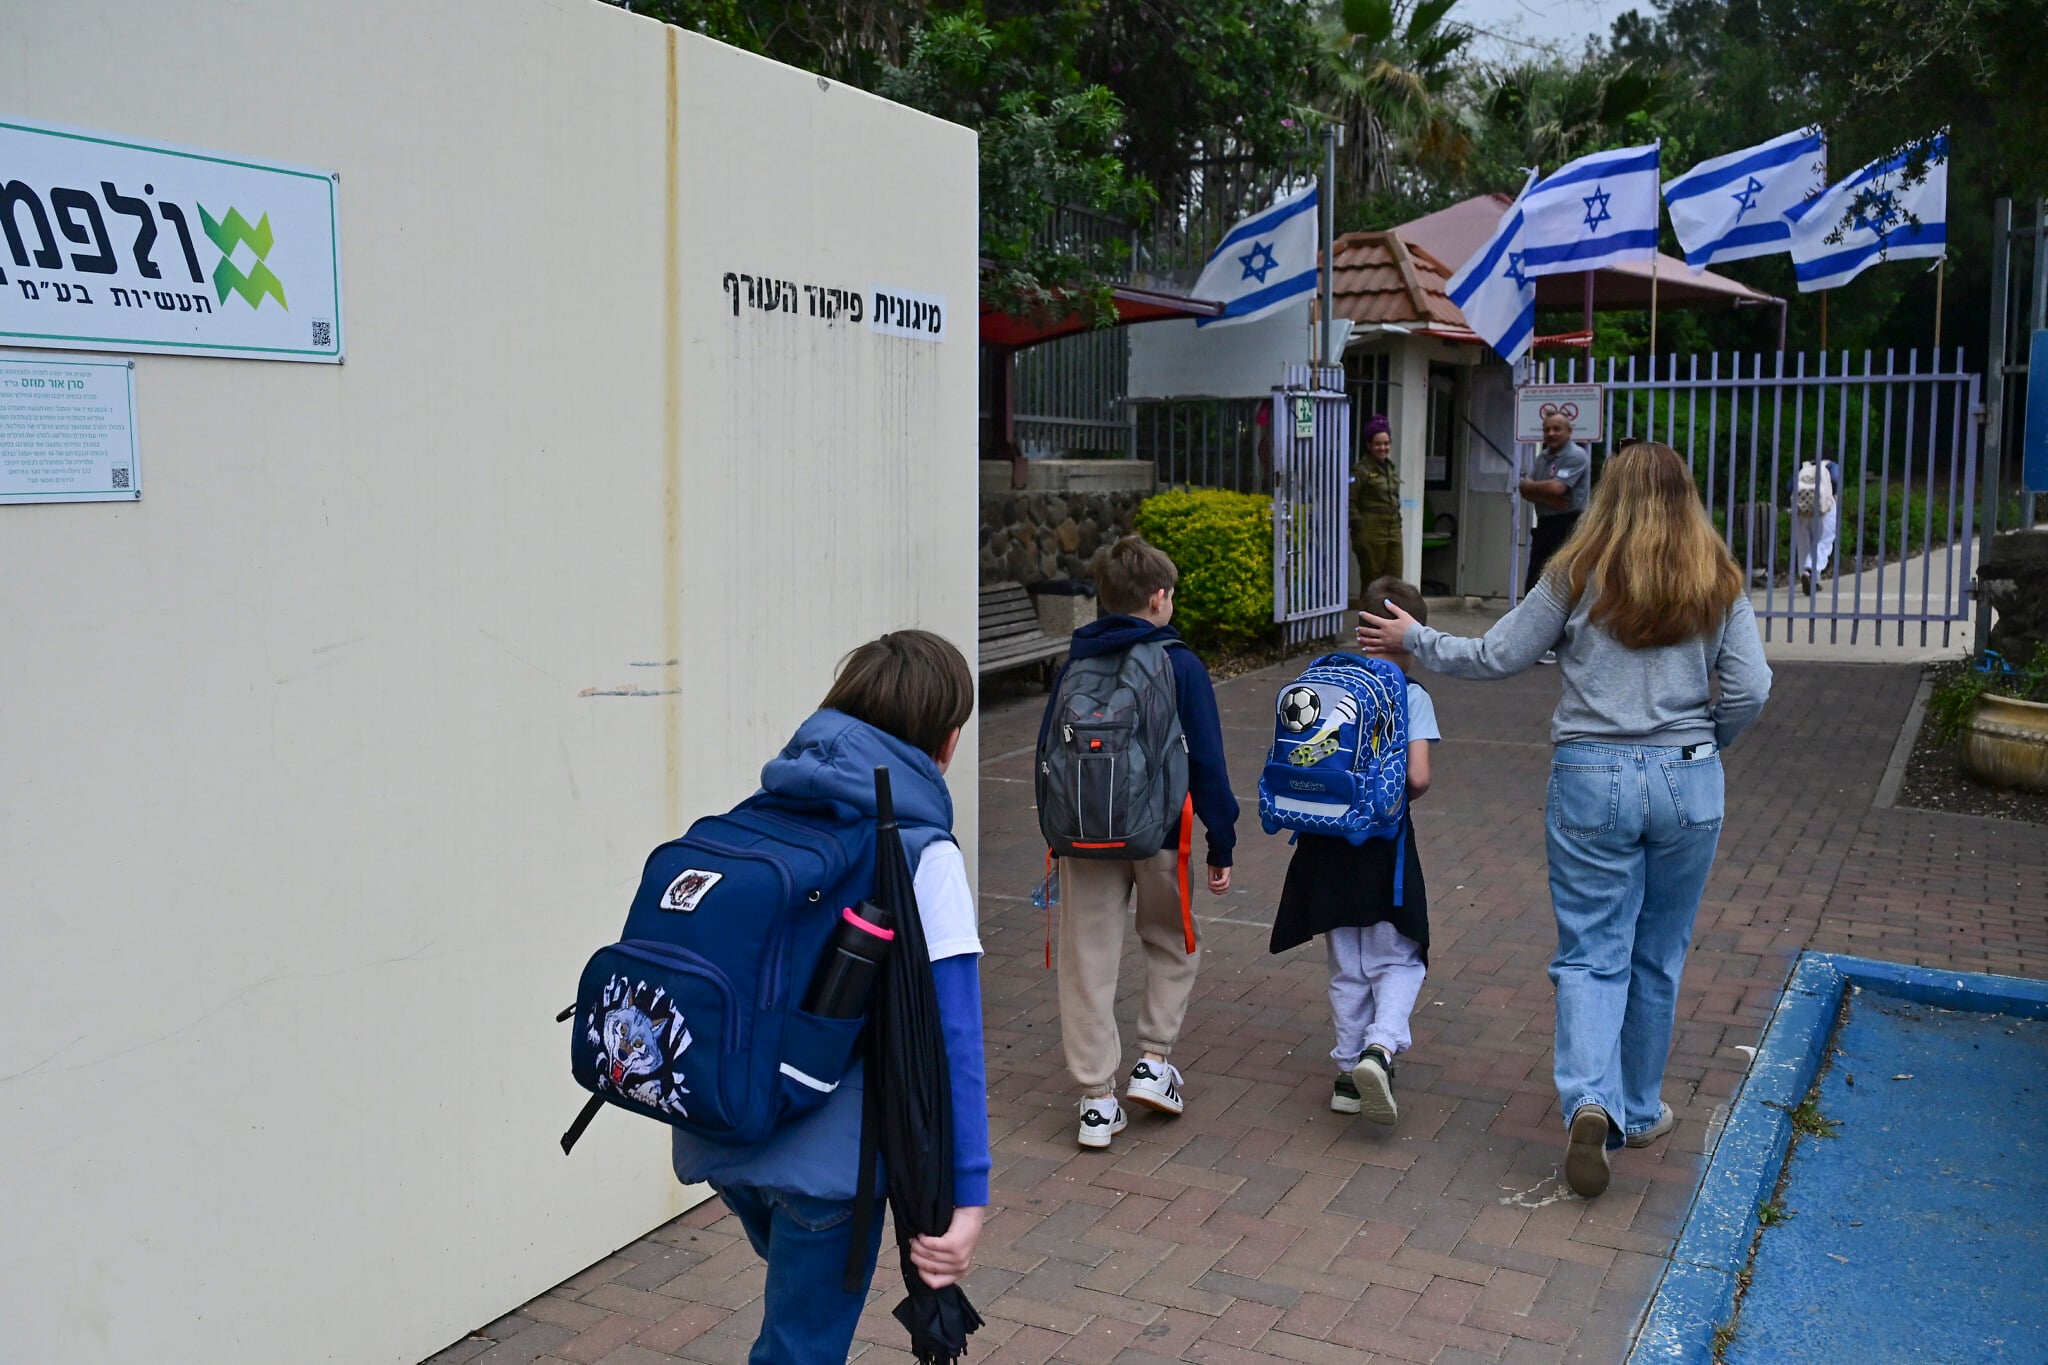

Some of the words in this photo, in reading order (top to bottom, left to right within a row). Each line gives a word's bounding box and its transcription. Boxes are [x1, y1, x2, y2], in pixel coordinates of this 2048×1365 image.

[17, 278, 94, 305] בע"מ
[110, 286, 212, 314] תעשיות
[723, 271, 798, 317] העורף
[803, 284, 864, 327] פיקוד
[873, 292, 942, 334] מיגונית
[21, 378, 45, 388] מוזס
[48, 379, 65, 389] אור
[67, 379, 84, 391] סרן
